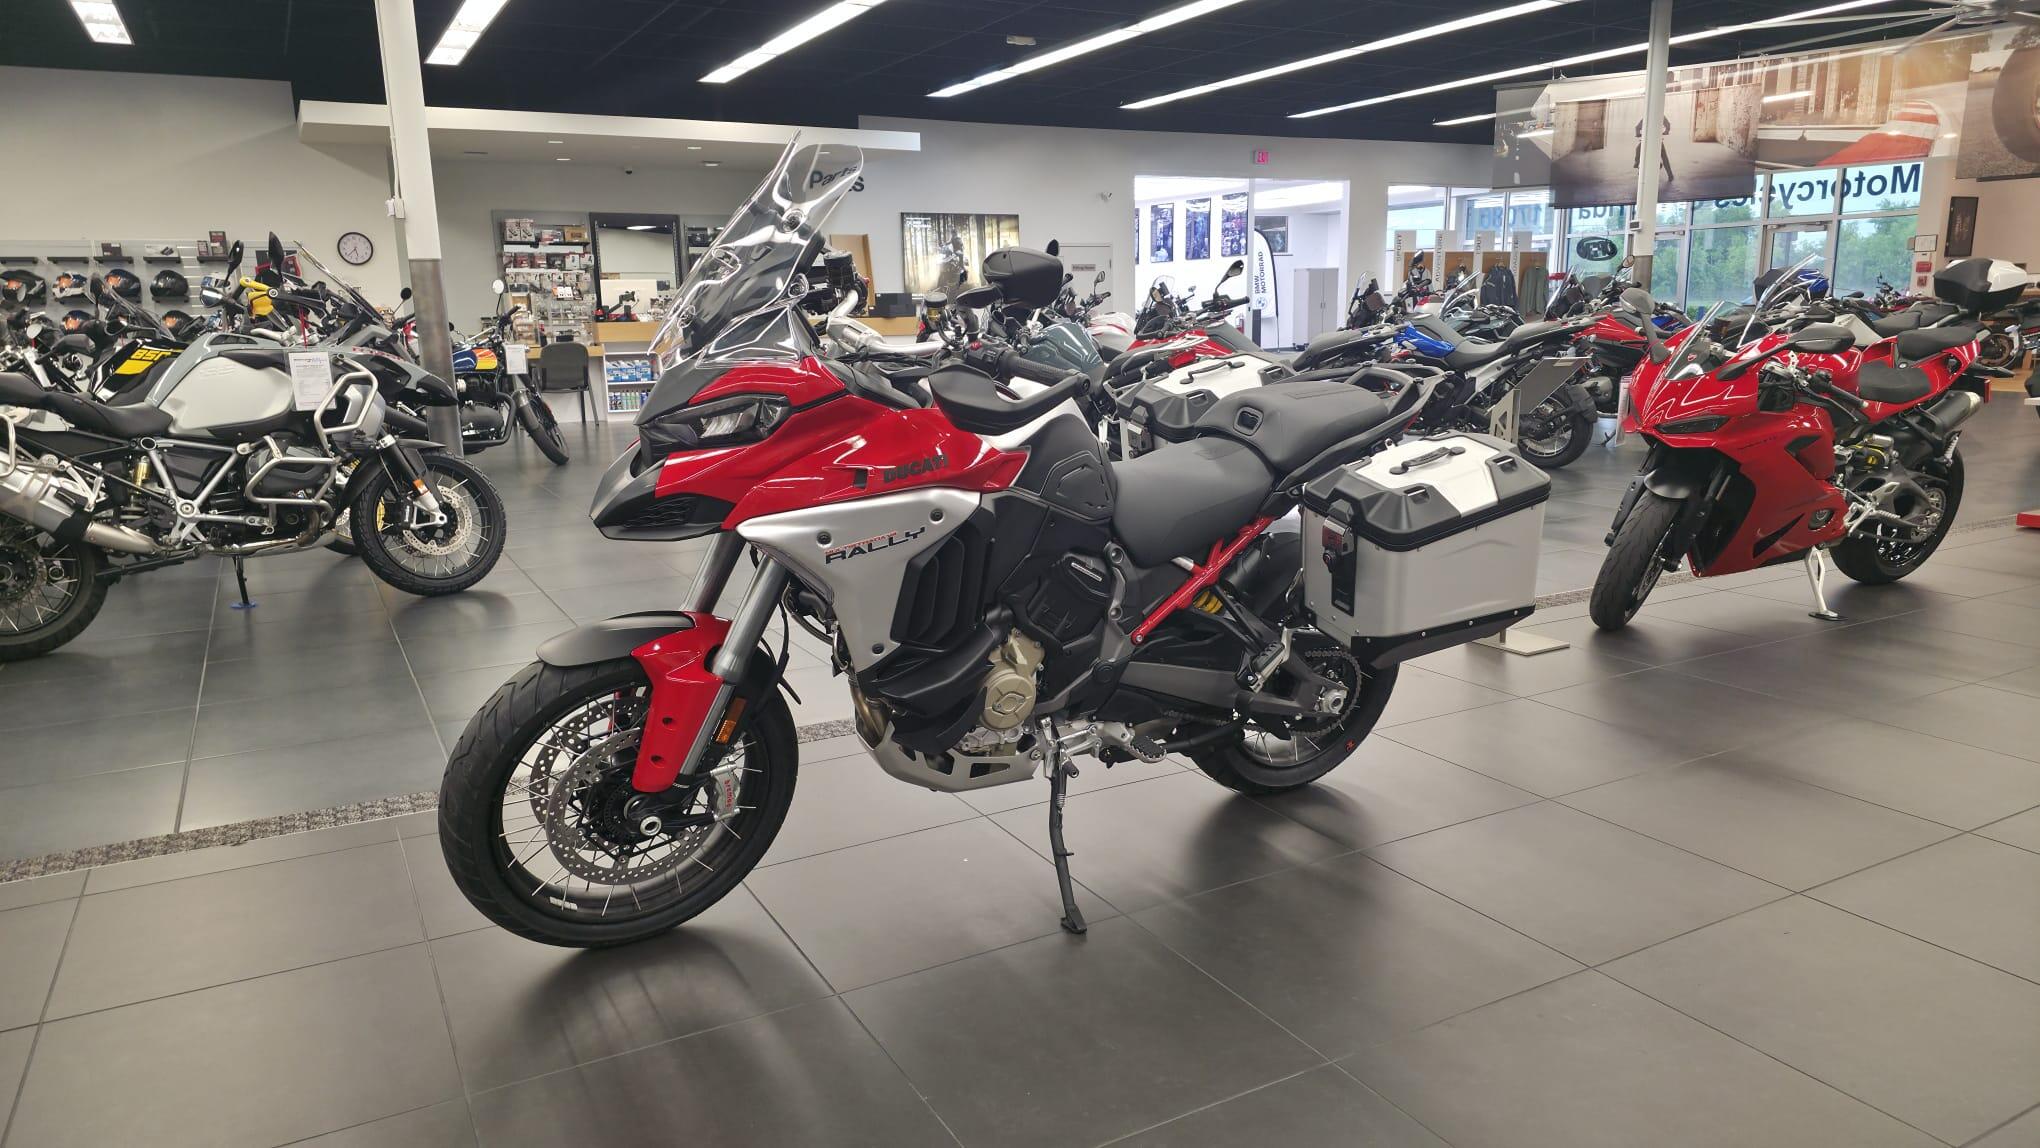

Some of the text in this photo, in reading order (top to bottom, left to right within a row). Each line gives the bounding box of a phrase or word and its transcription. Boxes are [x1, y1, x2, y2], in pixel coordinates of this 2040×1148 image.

[810, 165, 858, 189] Parts
[1258, 251, 1267, 294] MOTORRAD
[883, 453, 949, 483] DUCATI
[825, 526, 925, 564] RALLY
